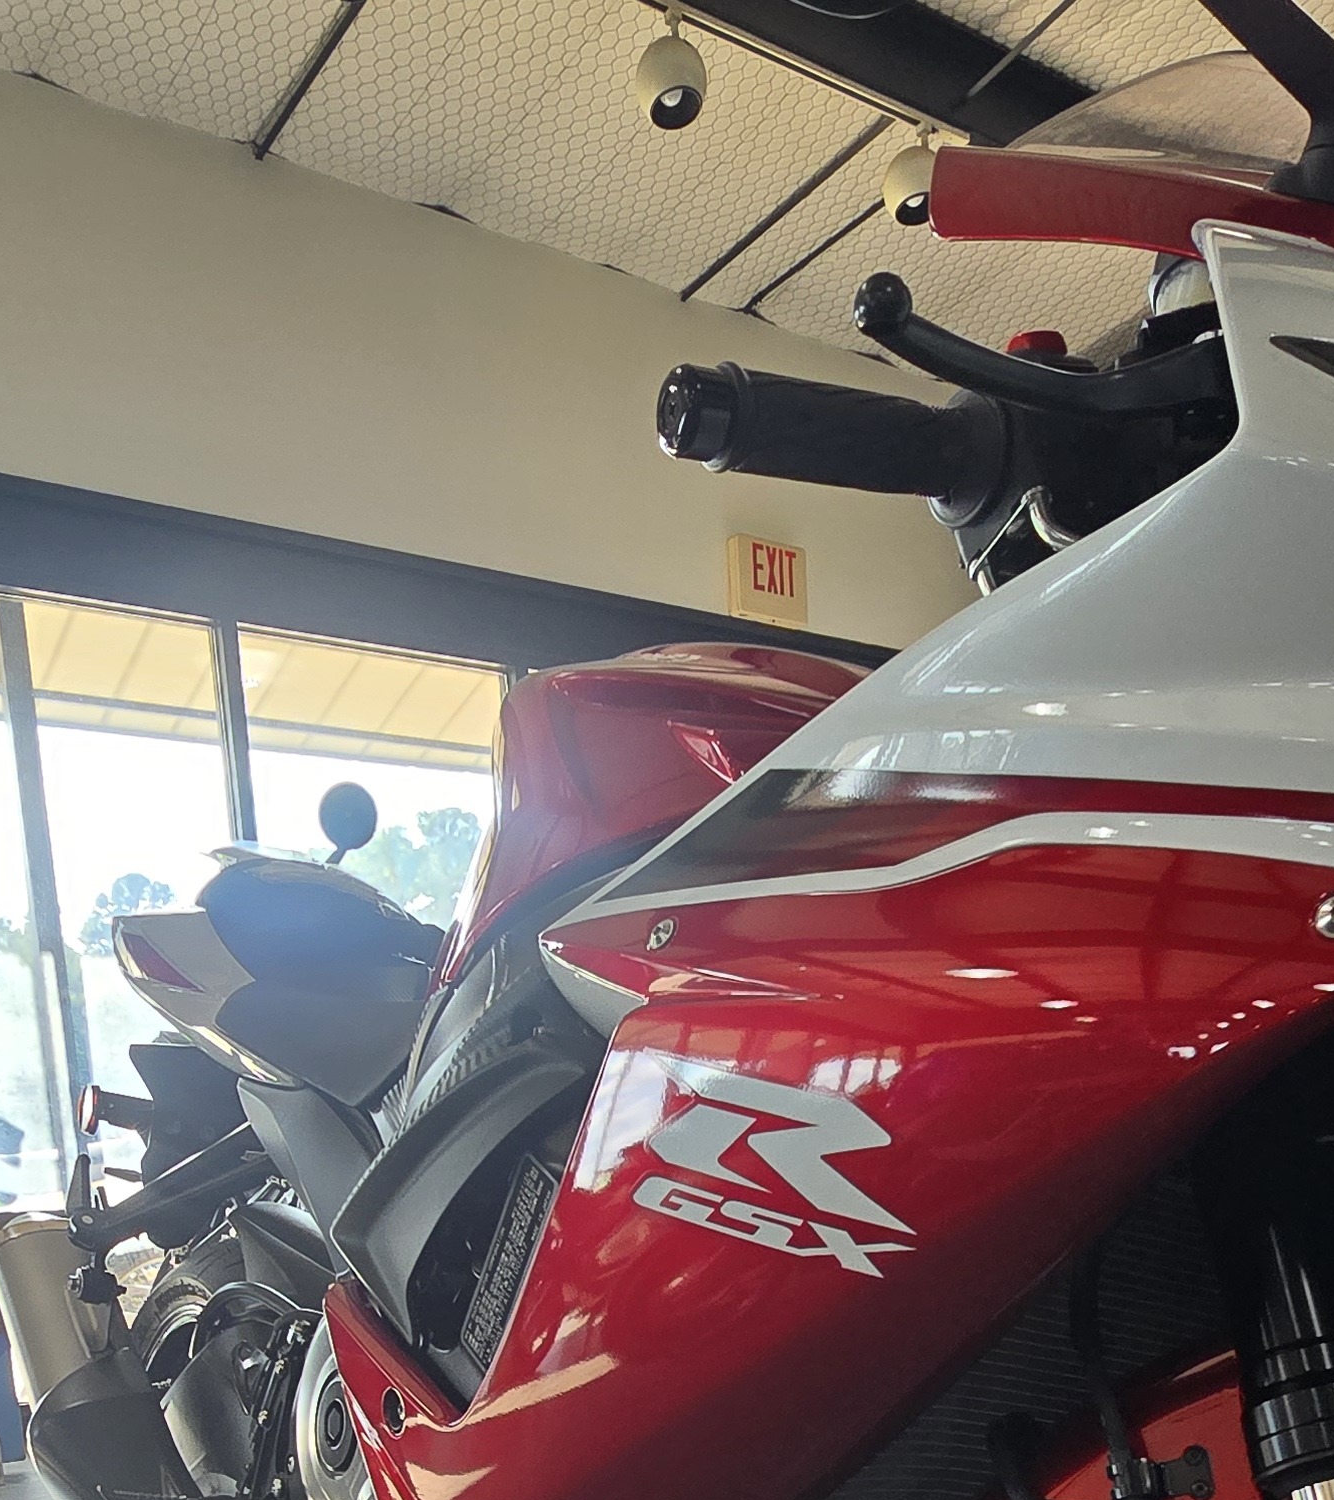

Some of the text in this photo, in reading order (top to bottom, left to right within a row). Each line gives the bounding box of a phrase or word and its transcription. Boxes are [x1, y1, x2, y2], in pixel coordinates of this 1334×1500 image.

[752, 541, 797, 598] EXIT
[650, 1052, 917, 1236] R
[632, 1175, 917, 1279] GSX
